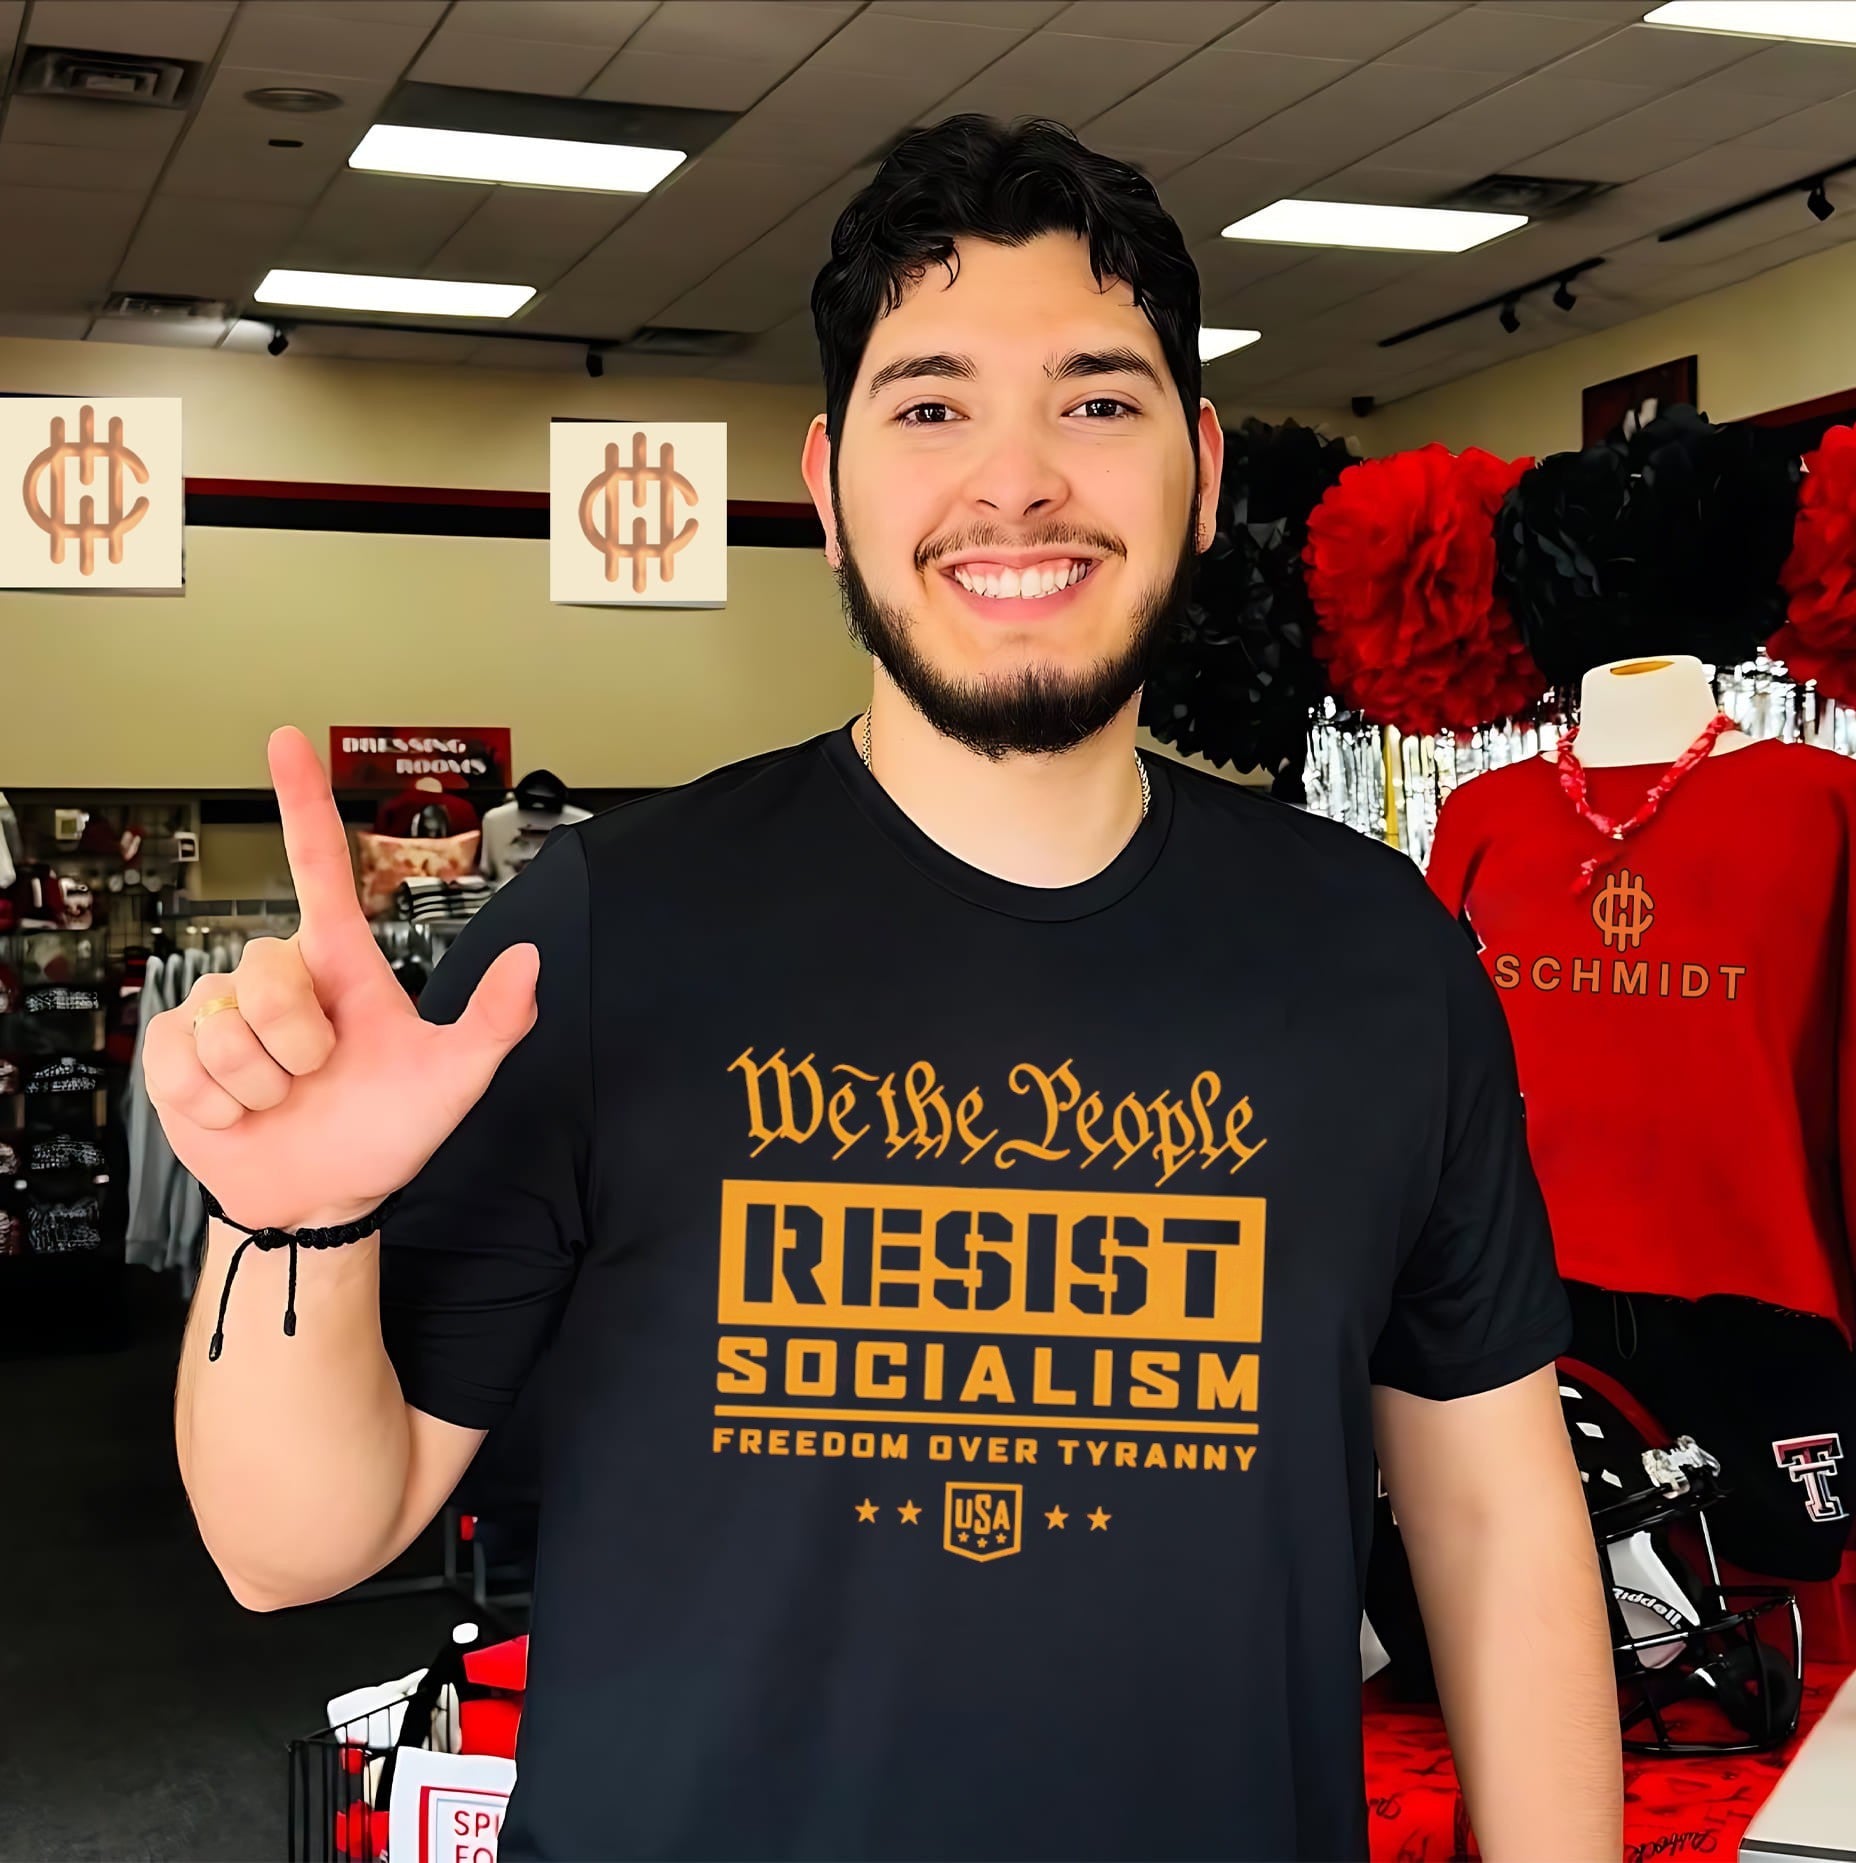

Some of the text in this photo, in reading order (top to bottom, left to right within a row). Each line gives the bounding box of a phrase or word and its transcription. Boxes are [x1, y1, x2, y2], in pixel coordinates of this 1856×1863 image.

[1494, 953, 1747, 1000] SCHMIDT
[876, 1060, 999, 1165] the
[994, 1058, 1268, 1188] People
[742, 1202, 1241, 1319] RESIST
[716, 1335, 1260, 1412] SOCIALISM
[712, 1427, 1257, 1472] FREEDOM OVER TYRANNY
[954, 1493, 1011, 1535] USA
